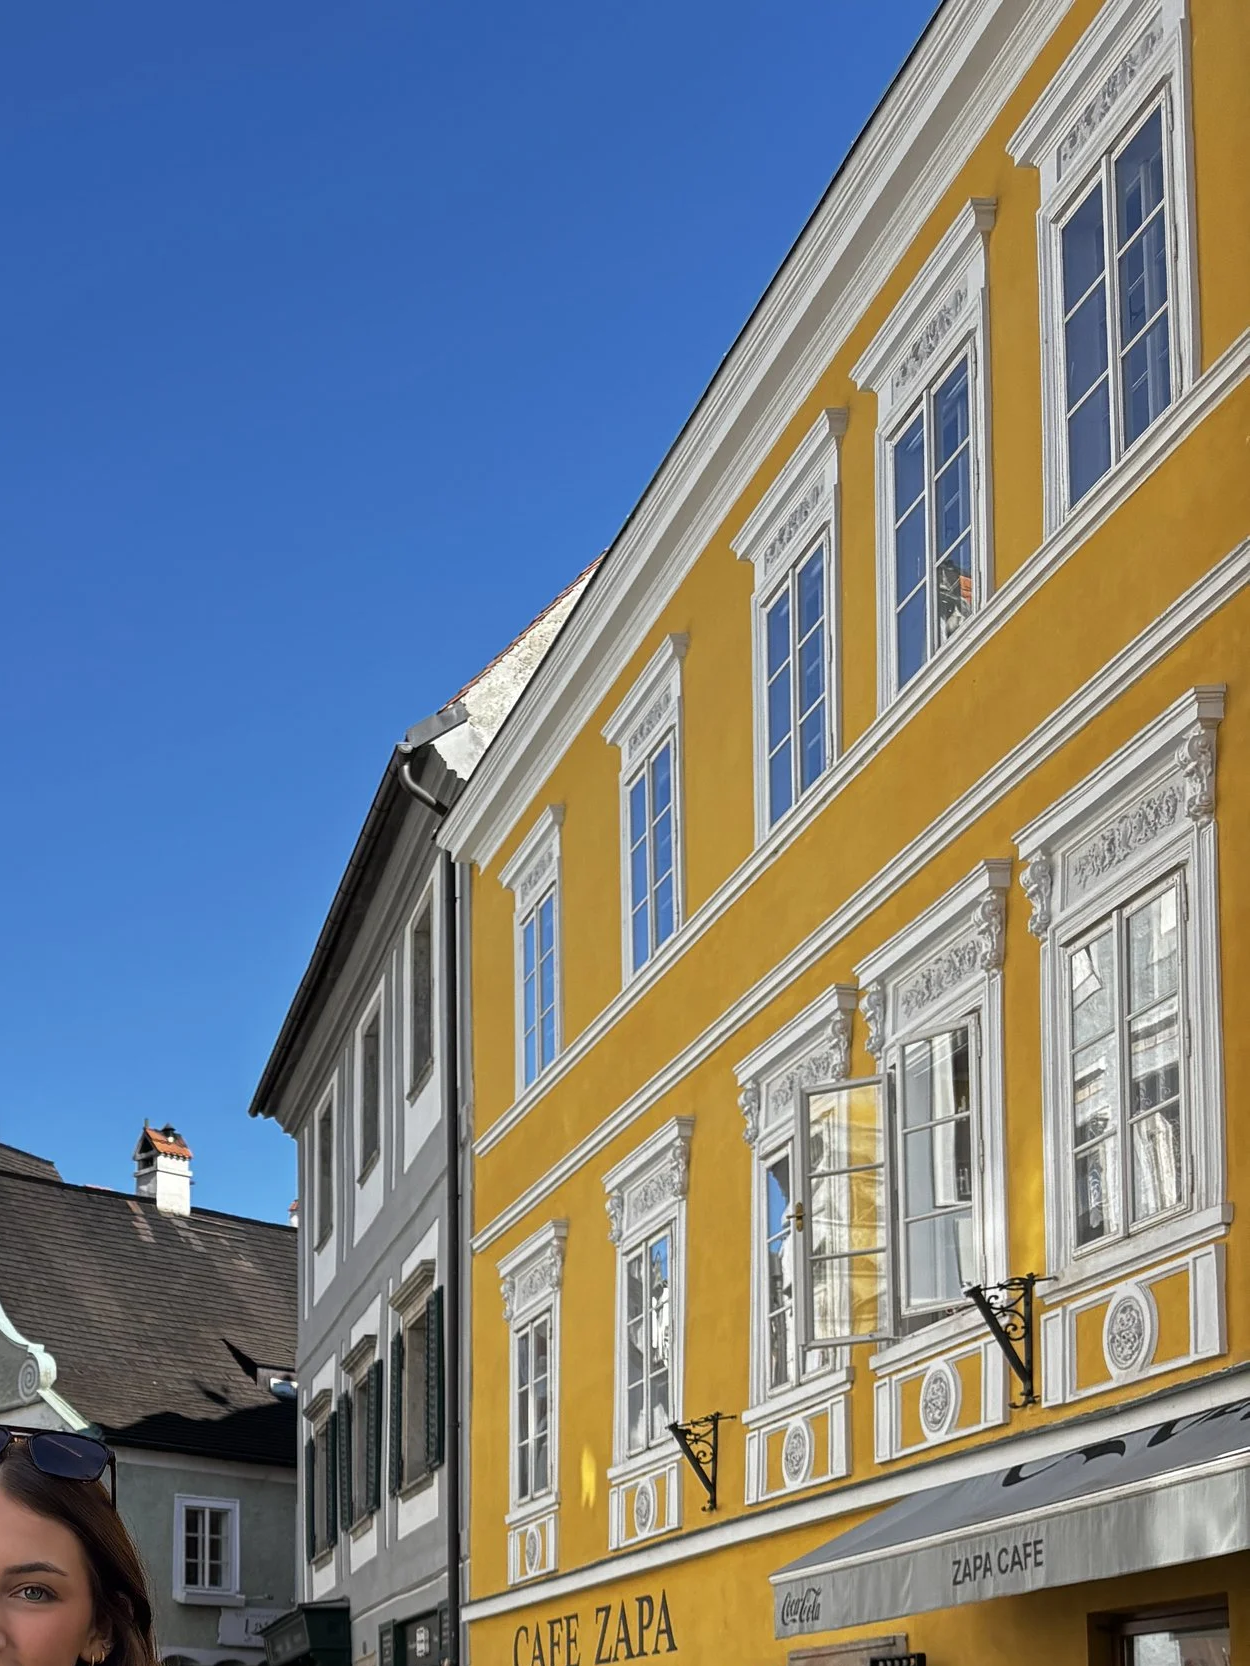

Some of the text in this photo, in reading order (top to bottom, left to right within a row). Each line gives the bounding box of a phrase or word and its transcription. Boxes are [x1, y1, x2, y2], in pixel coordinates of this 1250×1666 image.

[952, 1539, 1044, 1586] ZAPA CAFE
[595, 1589, 678, 1665] ZAPA
